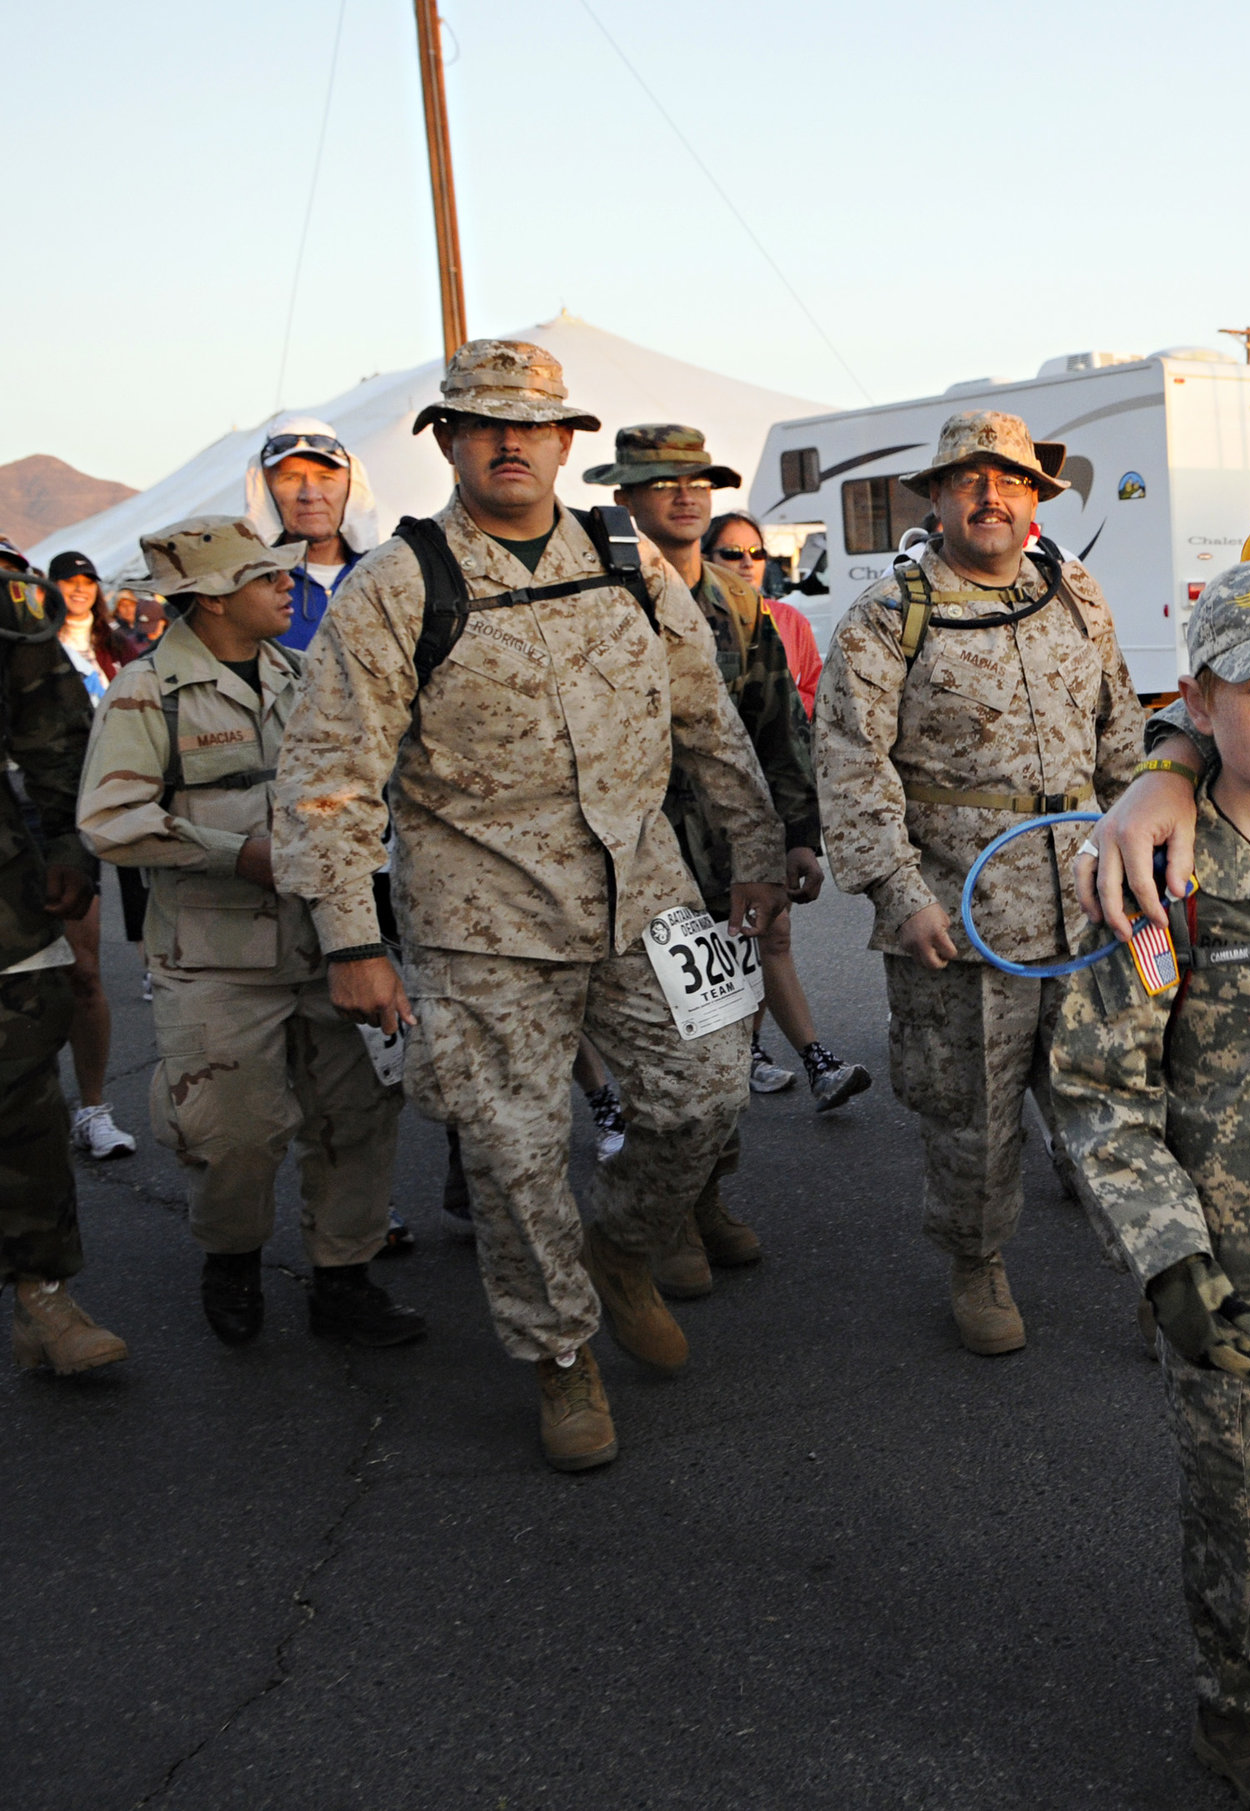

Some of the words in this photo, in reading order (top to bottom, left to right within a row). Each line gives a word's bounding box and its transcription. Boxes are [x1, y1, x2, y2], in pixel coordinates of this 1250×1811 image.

[848, 566, 886, 581] Ch
[473, 620, 547, 668] RODRIGUEZ
[196, 730, 244, 747] MACIAS
[701, 981, 735, 1001] TEAM
